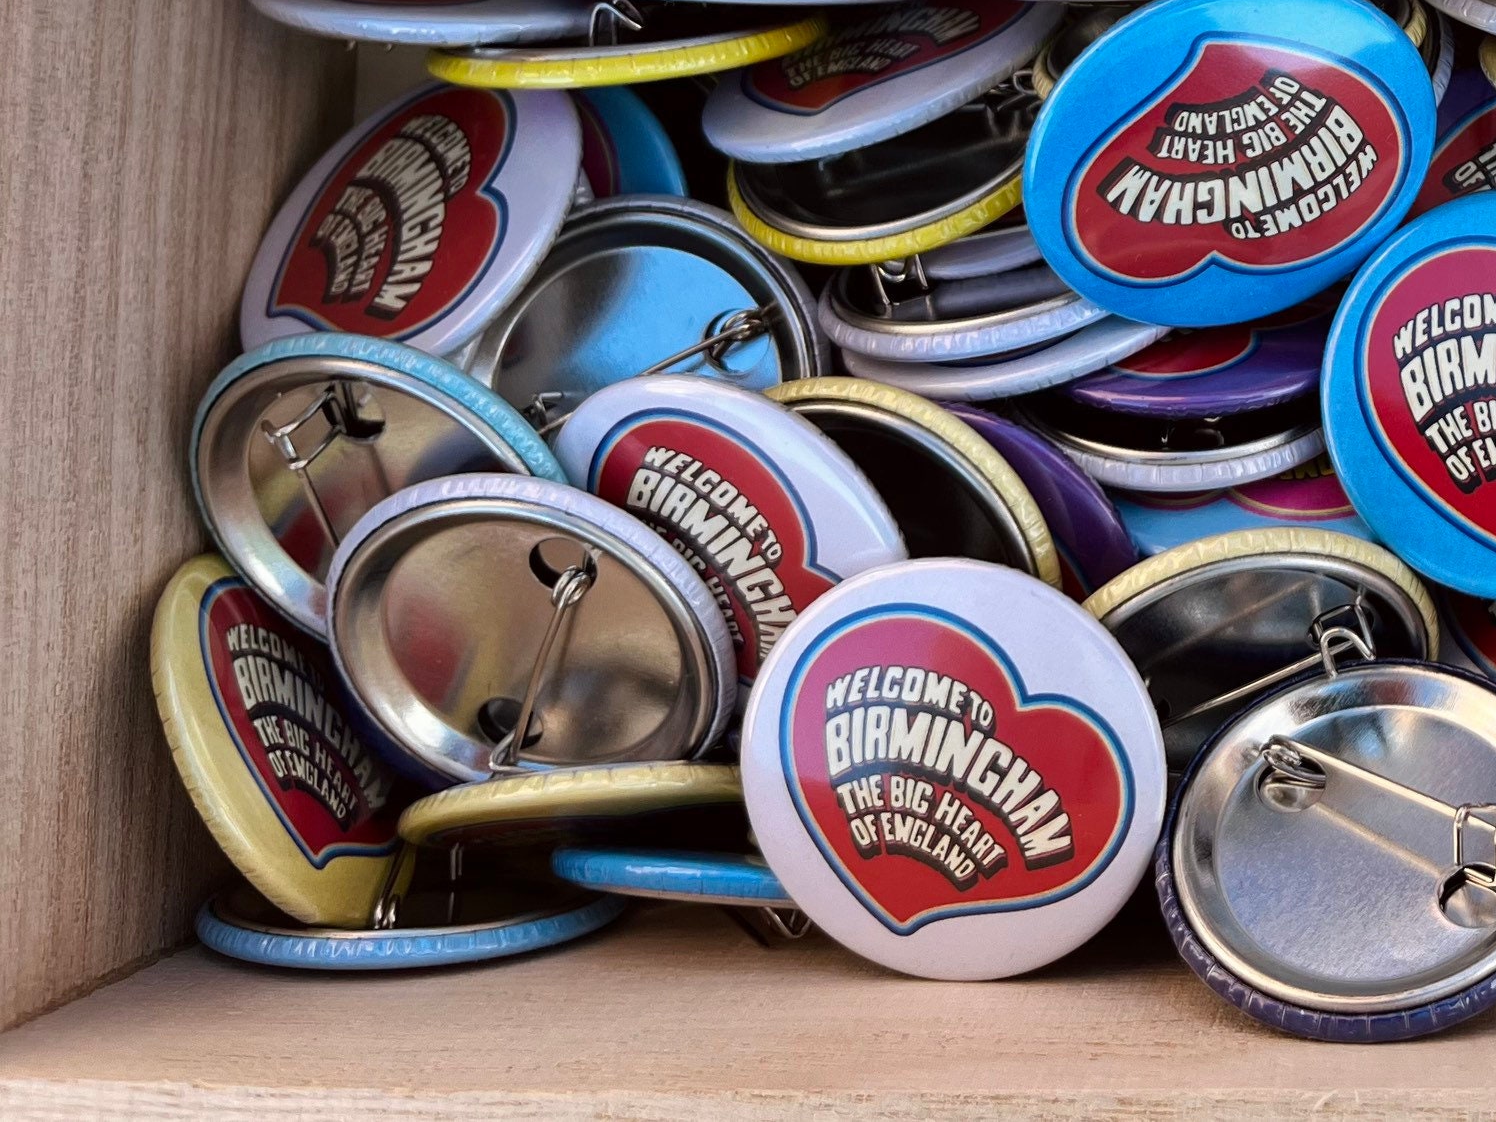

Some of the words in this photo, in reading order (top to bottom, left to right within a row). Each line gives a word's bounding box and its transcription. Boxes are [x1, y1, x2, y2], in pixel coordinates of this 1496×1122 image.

[1176, 96, 1279, 134] ENGLAND
[1269, 76, 1300, 105] OF
[1281, 90, 1327, 134] THE
[1106, 105, 1364, 224] BIRMINGHAM
[1156, 134, 1236, 164] HEART
[1243, 121, 1288, 158] BIG
[335, 186, 374, 214] THE
[1264, 145, 1378, 237] WELCOME
[1454, 161, 1486, 187] OF
[356, 138, 445, 308] BIRMINGHAM
[357, 196, 387, 234] BIG
[1231, 220, 1260, 239] TO
[330, 216, 359, 294] ENGLAND
[351, 225, 388, 294] HEART
[1425, 405, 1473, 454] THE
[1446, 447, 1476, 482] OF
[644, 446, 769, 537] WELCOME
[761, 530, 782, 560] TO
[826, 666, 968, 714] WELCOME
[969, 691, 994, 728] TO
[233, 655, 388, 808] BIRMINGHAM
[253, 715, 284, 747] THE
[283, 719, 311, 756] BIG
[315, 742, 358, 810] HEART
[268, 750, 288, 778] OF
[285, 750, 347, 819] ENGLAND
[826, 706, 1072, 858] BIRMINGHAM
[837, 775, 884, 814] THE
[890, 776, 934, 817] BIG
[935, 792, 1006, 866] HEART
[851, 815, 880, 846] OF
[881, 812, 976, 878] ENGLAND
